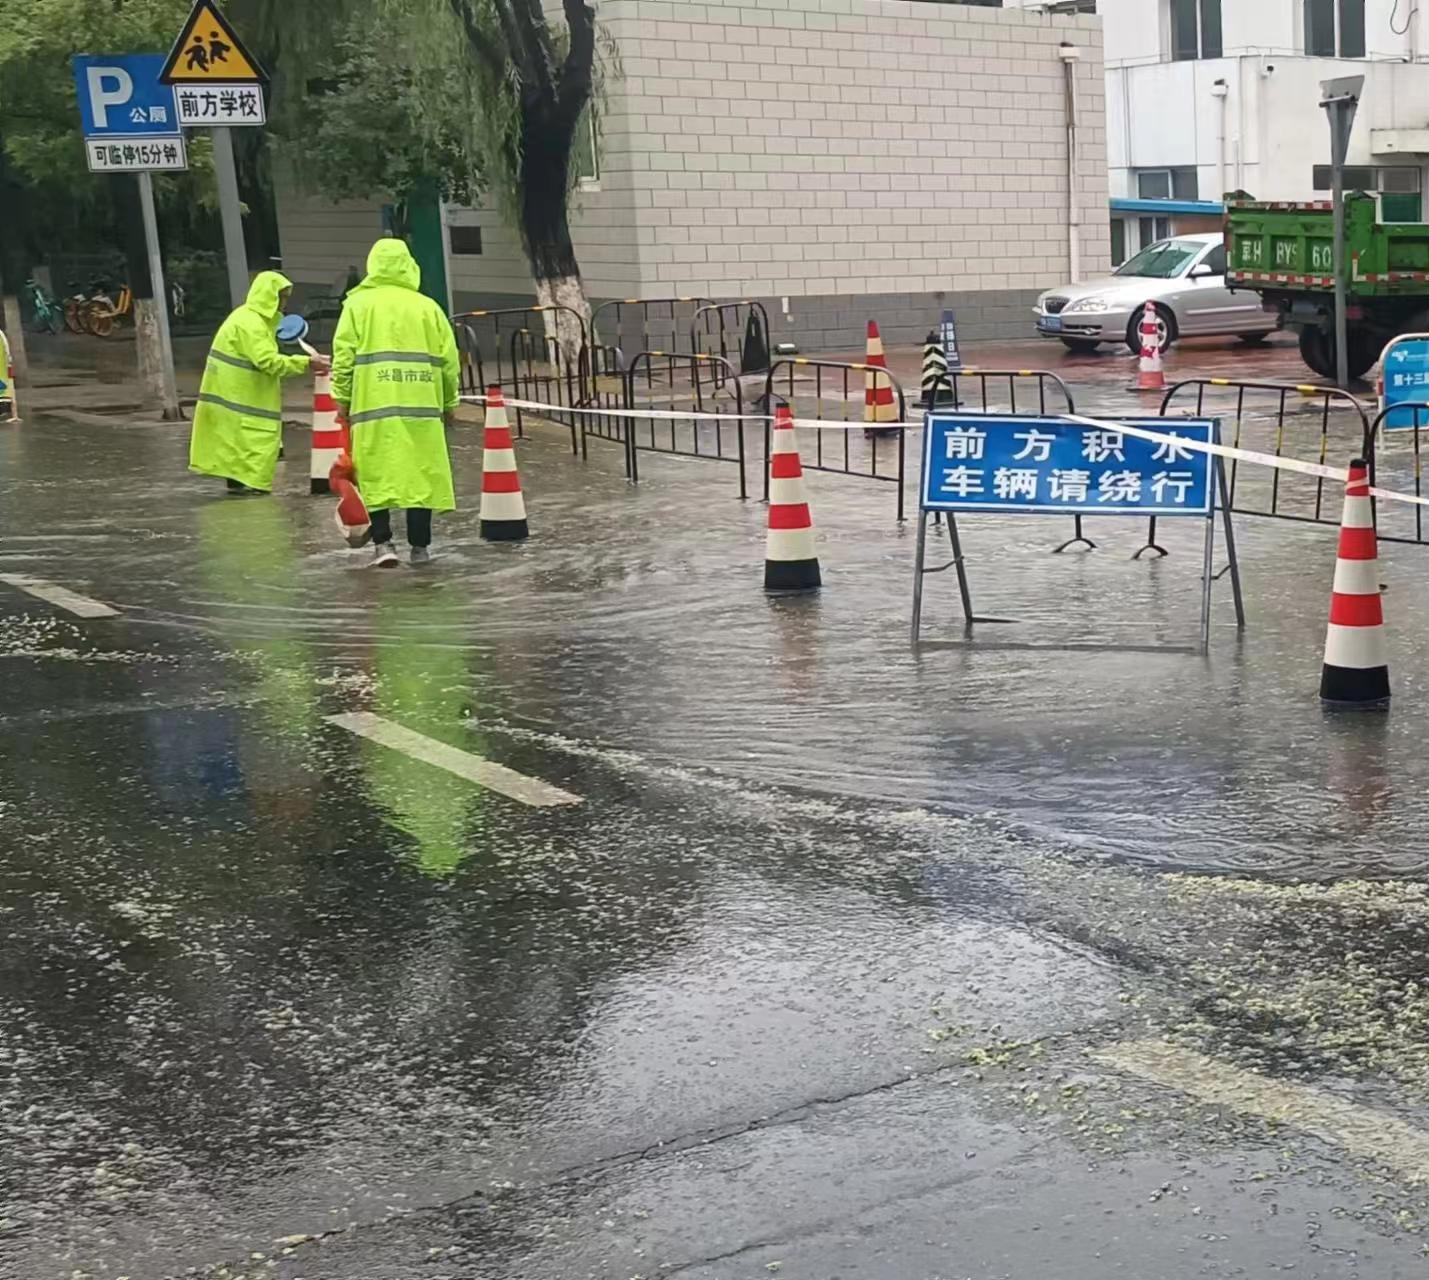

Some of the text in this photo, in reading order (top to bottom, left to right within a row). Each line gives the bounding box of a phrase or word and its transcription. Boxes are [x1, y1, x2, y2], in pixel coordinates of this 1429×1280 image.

[86, 66, 134, 128] P
[179, 90, 258, 118] 前方学校
[129, 106, 168, 124] 公厕
[94, 143, 178, 166] 可临停15分钟
[376, 367, 432, 383] 兴昌市政
[943, 426, 1195, 463] 前方积水
[940, 465, 1194, 504] 车辆请绕行
